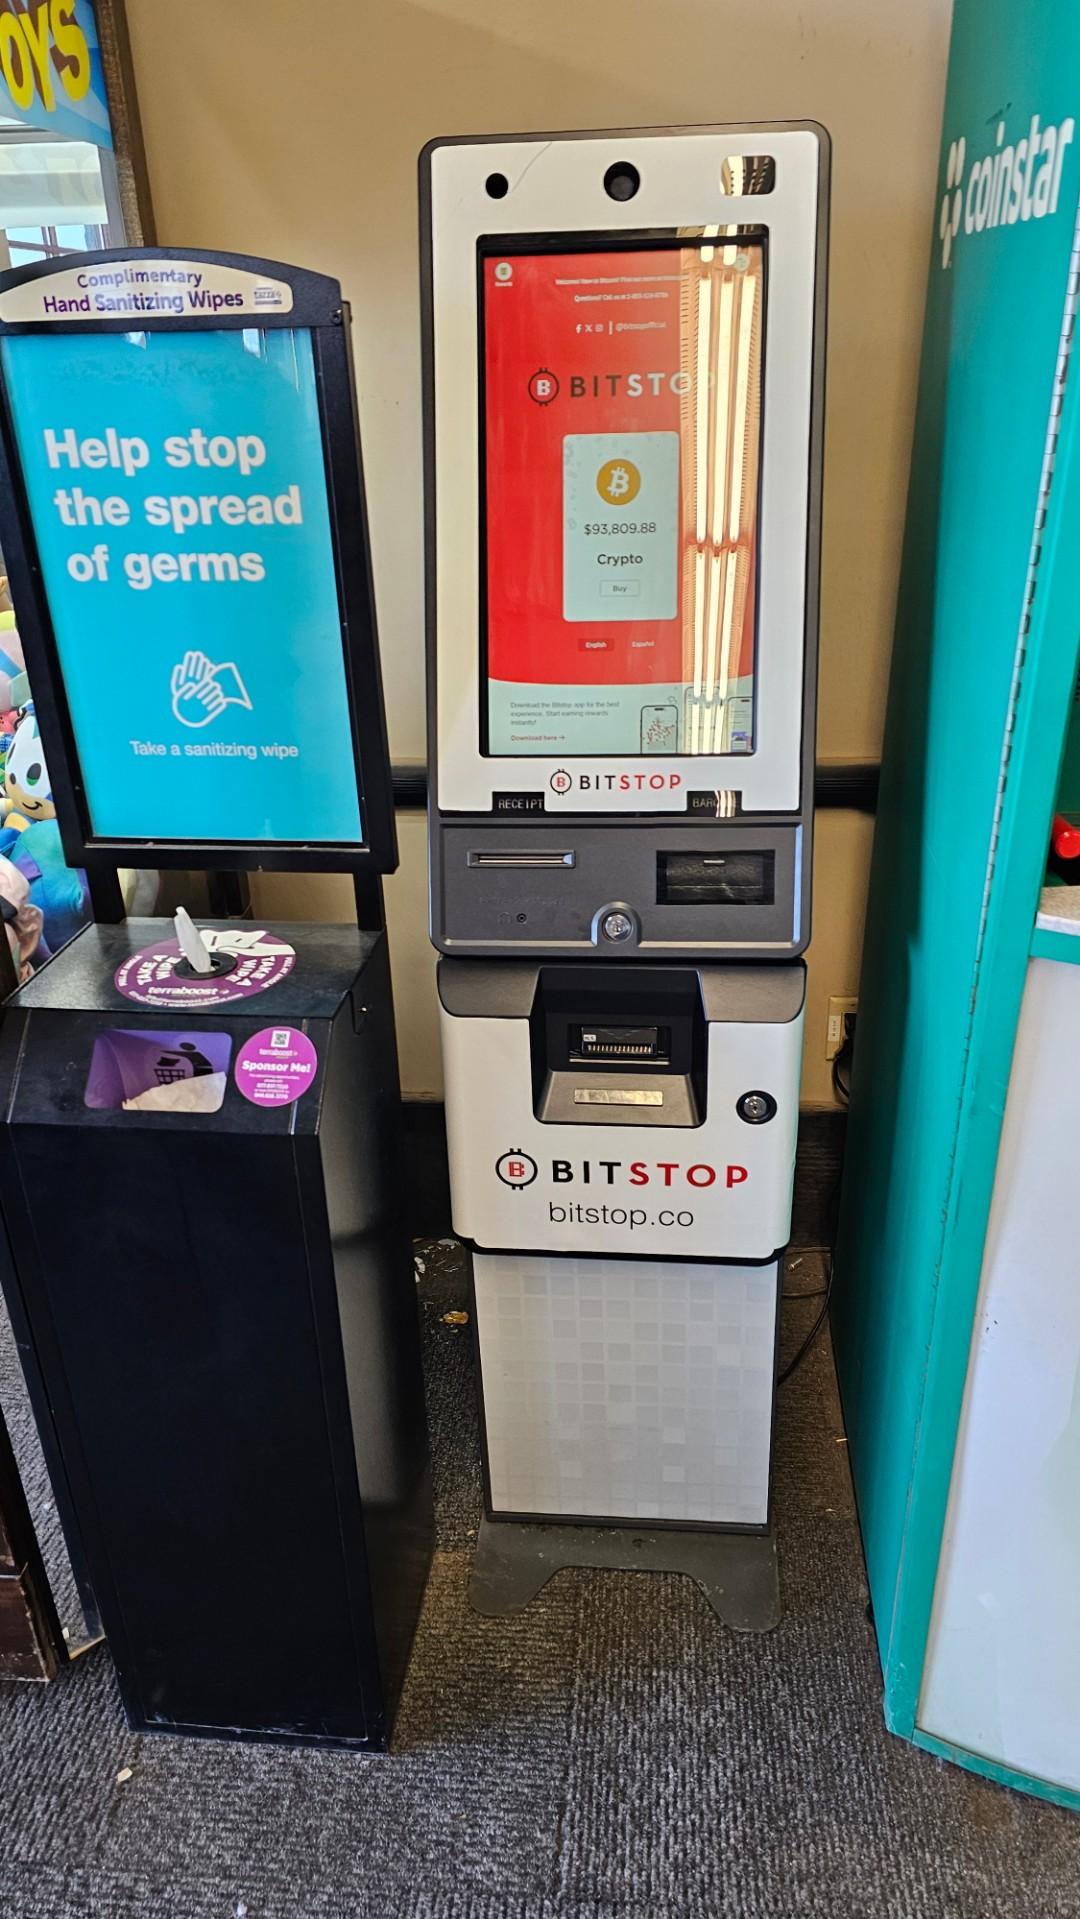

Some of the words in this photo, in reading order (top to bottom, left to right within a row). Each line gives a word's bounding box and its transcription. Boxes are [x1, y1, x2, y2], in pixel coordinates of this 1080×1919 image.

[965, 114, 1075, 235] coinstar
[77, 268, 202, 290] Complimentary
[43, 294, 90, 313] Hand
[94, 291, 184, 314] Sanitizing
[189, 289, 244, 311] Wipes
[569, 372, 715, 398] BITSTO
[44, 428, 149, 477] Help
[163, 428, 266, 475] stop
[54, 487, 131, 526] the
[144, 485, 303, 534] spread
[584, 522, 657, 536] $93,809.88
[66, 544, 110, 582] of
[123, 551, 266, 590] germs
[597, 553, 644, 567] Crypto
[612, 584, 628, 594] Buy
[585, 641, 607, 650] English
[129, 740, 166, 757] Take
[170, 744, 181, 757] a
[184, 741, 257, 760] sanitizing
[260, 742, 299, 760] wipe
[579, 774, 682, 791] BITSTOP
[498, 799, 543, 810] RECEIPT
[136, 961, 158, 986] TAKE
[148, 986, 219, 996] terraboost
[241, 1060, 289, 1072] Sponsor
[290, 1062, 311, 1073] Me!
[551, 1159, 749, 1189] BITSTOP
[549, 1201, 695, 1231] bitstop.co
